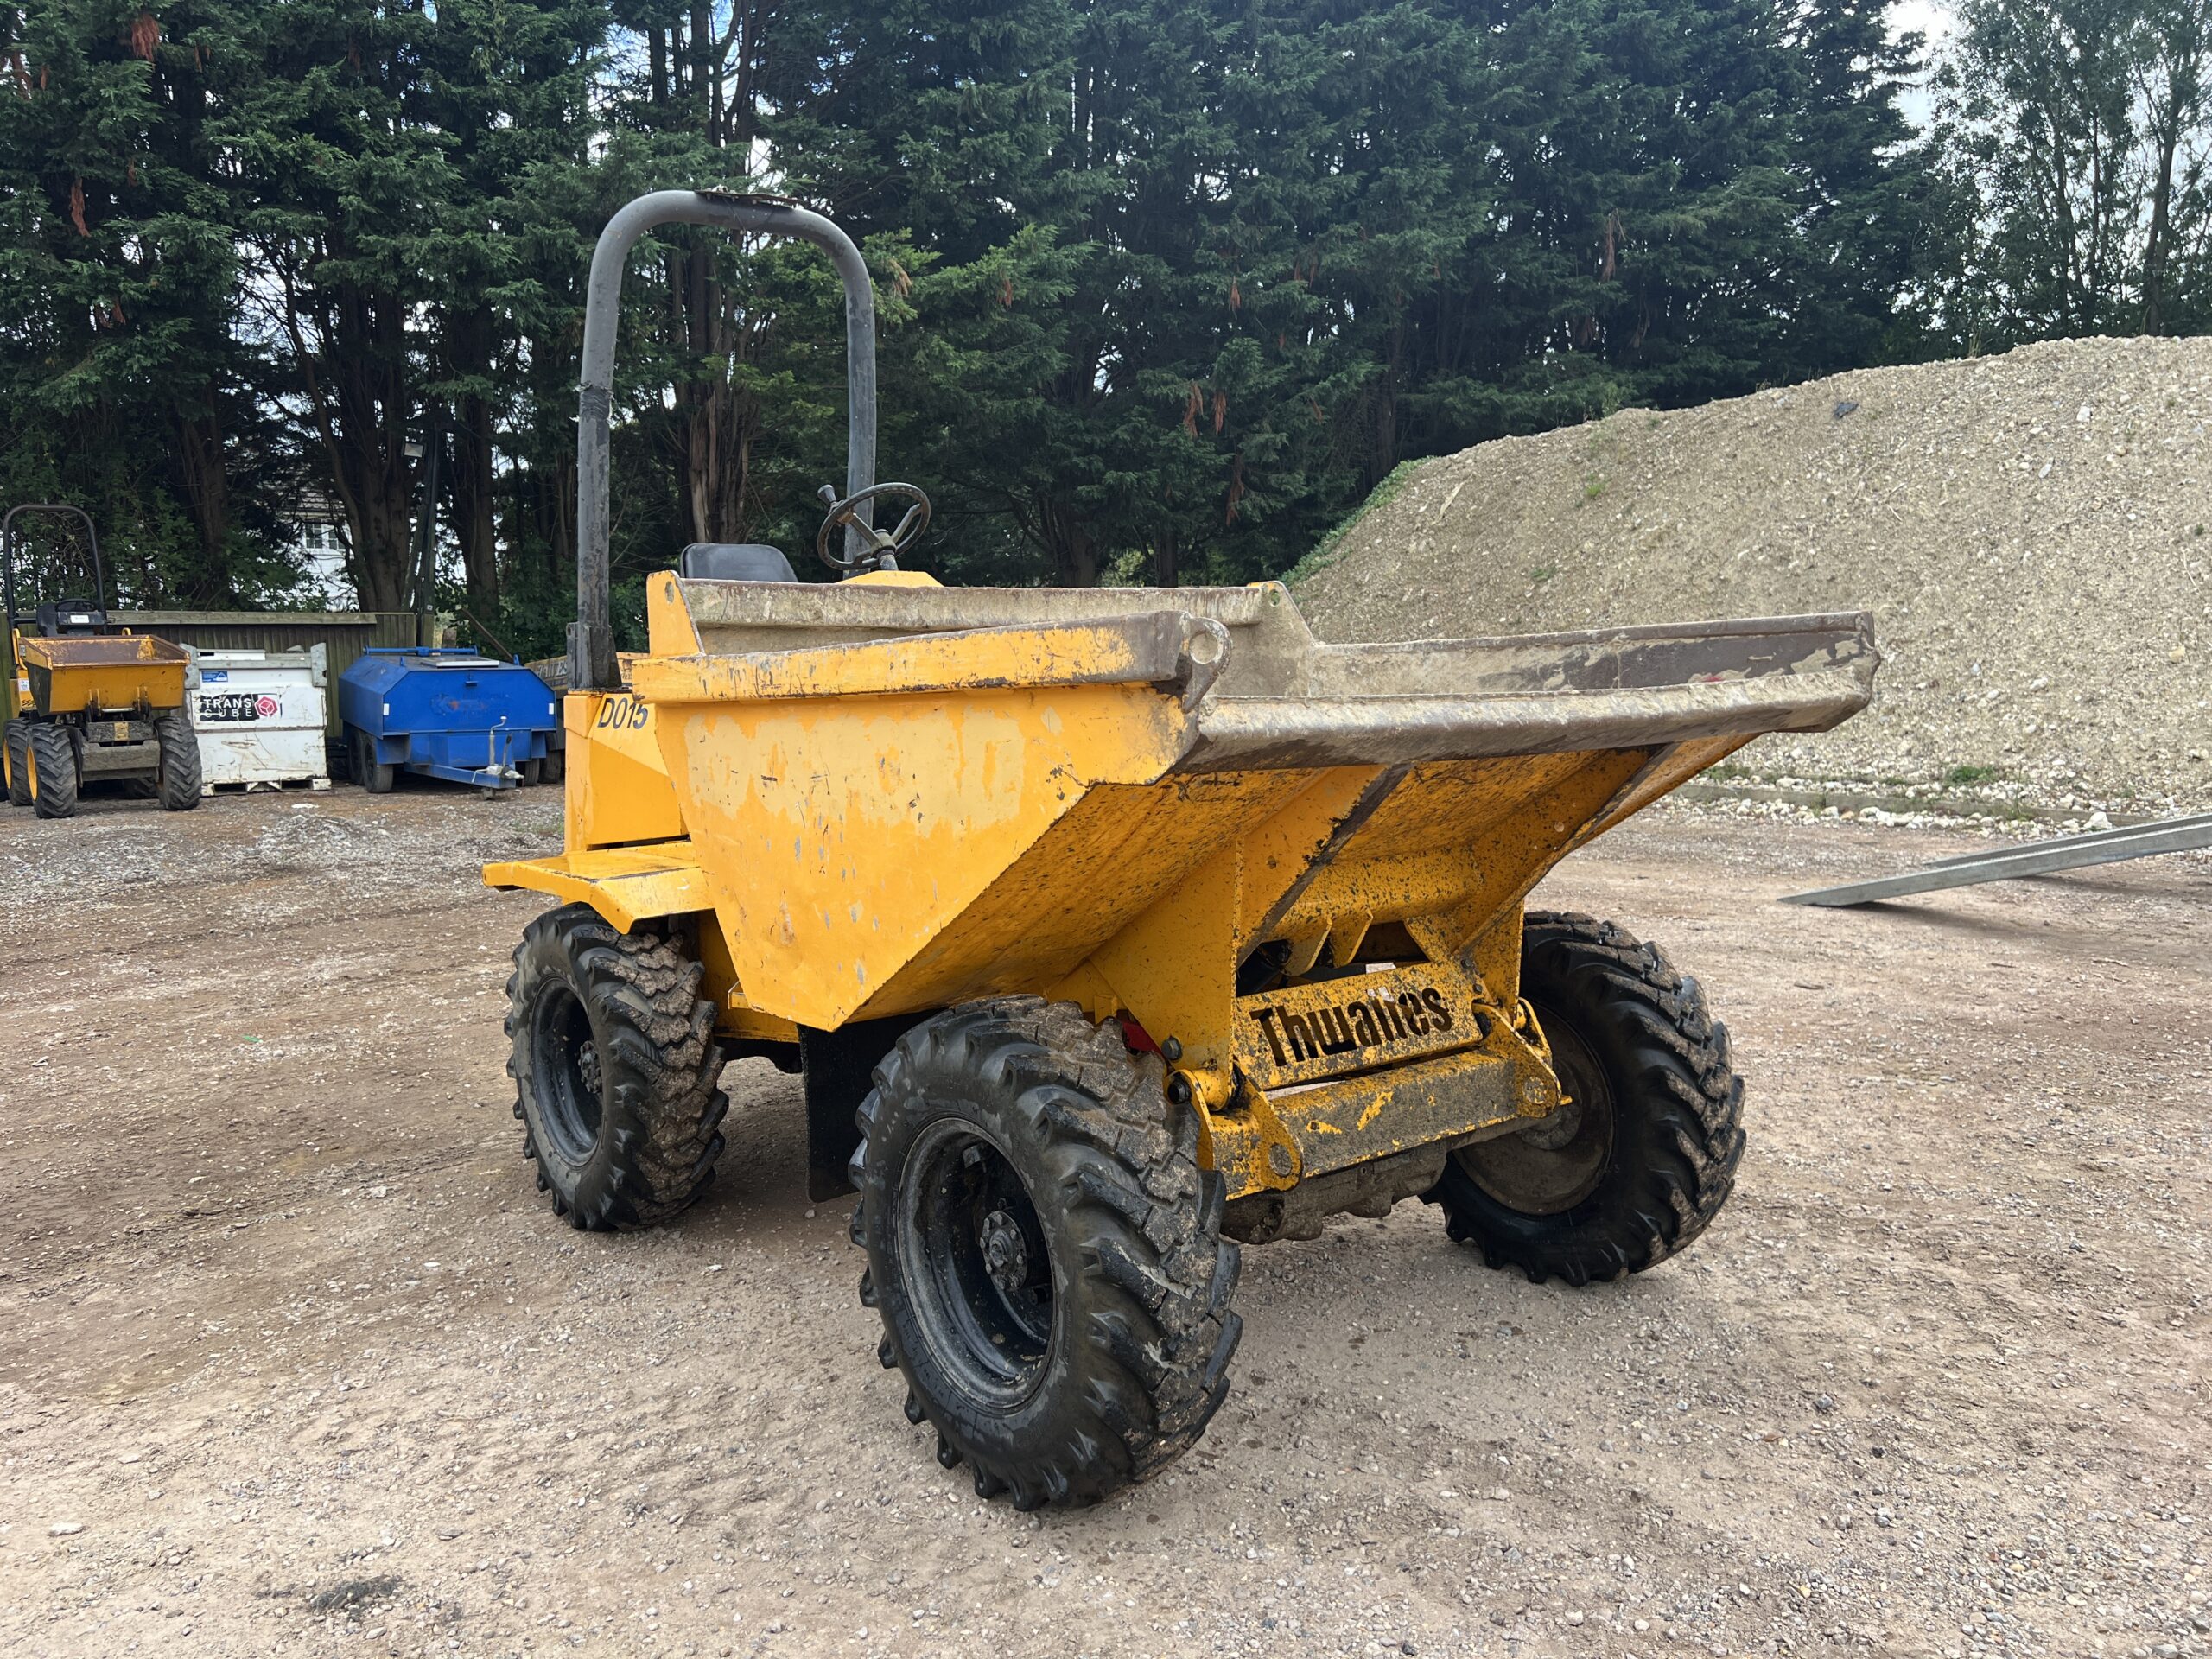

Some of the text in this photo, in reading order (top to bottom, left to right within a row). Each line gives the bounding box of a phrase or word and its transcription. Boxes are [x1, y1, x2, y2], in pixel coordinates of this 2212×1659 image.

[203, 697, 252, 709] TRANS
[204, 709, 252, 718] CUBE
[1249, 986, 1452, 1067] Thwaites
